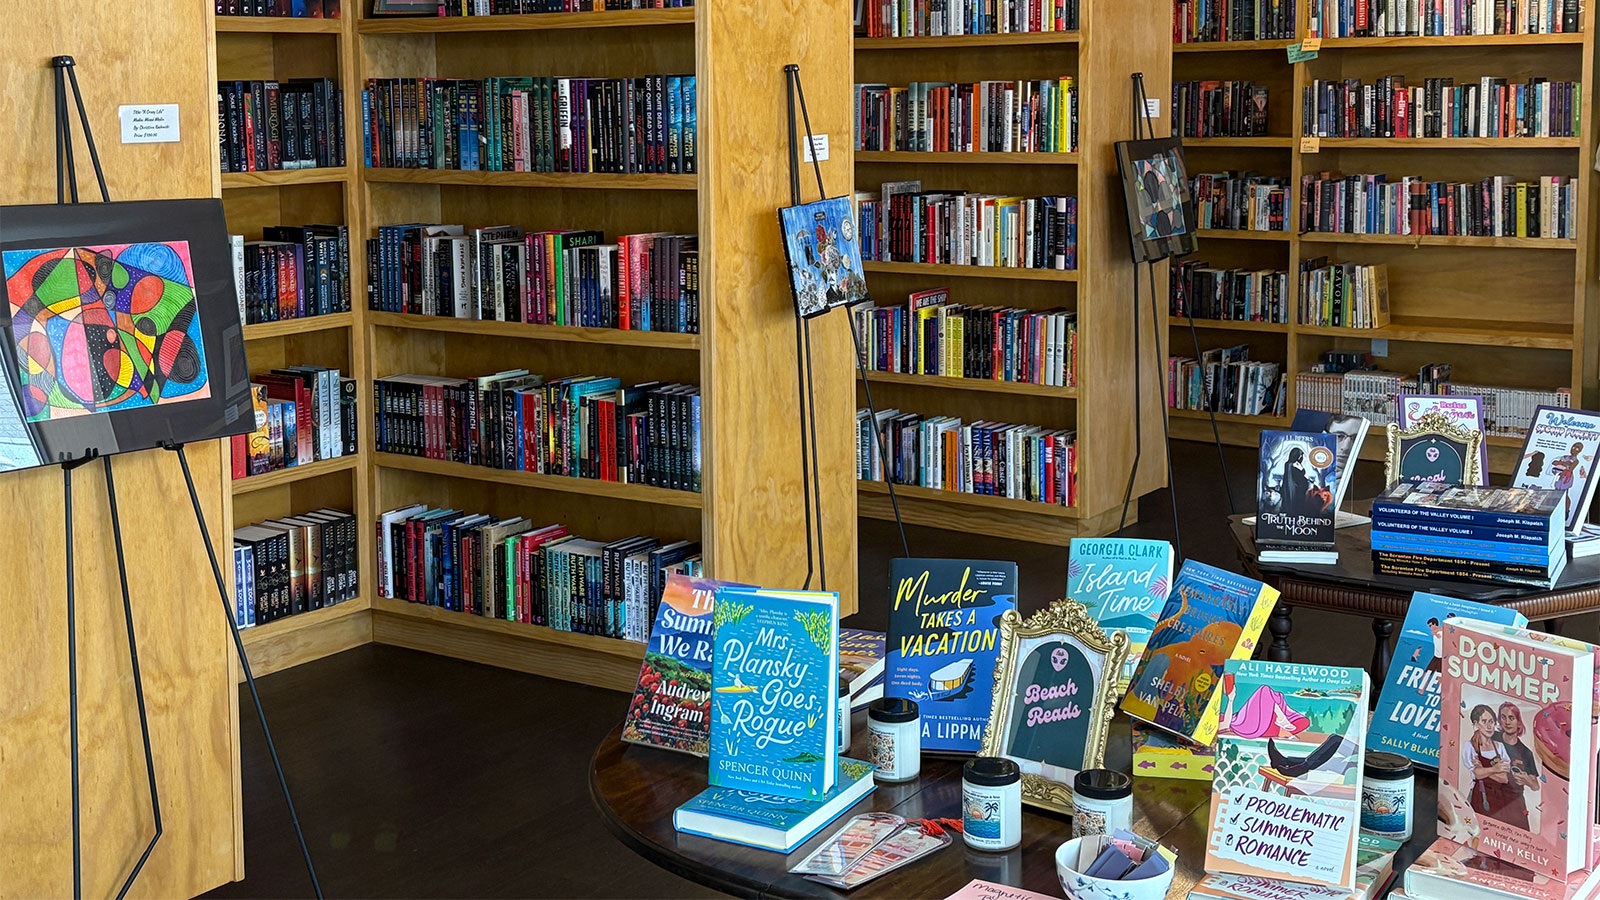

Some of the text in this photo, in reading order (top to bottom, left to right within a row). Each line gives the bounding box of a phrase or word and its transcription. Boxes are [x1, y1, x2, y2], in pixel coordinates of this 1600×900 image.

[269, 97, 279, 142] MURTAGH
[559, 95, 568, 127] GRIFFIN
[306, 231, 314, 263] ENIGMA
[481, 230, 518, 242] STEPHEN
[569, 235, 596, 246] SHARI
[504, 262, 512, 287] KING
[618, 258, 626, 298] CONFIDENTIAL
[1334, 268, 1342, 304] SAVOR
[468, 394, 476, 430] MEZRICH
[1440, 401, 1467, 409] Rules
[505, 410, 514, 458] DEEP DARK
[1536, 424, 1600, 442] SECOND PUBERTY
[1546, 412, 1596, 429] Welcome
[972, 433, 982, 472] MISSION
[983, 433, 992, 472] MISSION
[1045, 447, 1053, 464] WAR
[1261, 513, 1332, 528] TRUTH BEHIND
[1284, 525, 1318, 536] MOON
[1496, 532, 1513, 540] Joseph
[1080, 543, 1163, 558] GEORGIA CLARK
[1424, 556, 1452, 564] Department
[1074, 563, 1158, 594] Island
[1198, 570, 1209, 578] YORK
[1210, 573, 1225, 582] TIMES
[1226, 578, 1258, 592] BESTSELLER
[1426, 568, 1454, 576] Department
[692, 588, 714, 612] Th
[894, 566, 988, 616] Murder
[1098, 588, 1154, 619] Time
[1178, 584, 1246, 615] REMARKABLY
[661, 608, 713, 636] Sum
[920, 609, 976, 629] TAKES A
[1184, 605, 1224, 626] BRIGHT
[756, 628, 789, 650] Mrs.
[901, 628, 998, 658] VACATION
[1168, 618, 1226, 646] CREATURES
[660, 634, 712, 662] We Ra
[1179, 654, 1192, 664] NOVEL
[1458, 635, 1555, 680] DONUT
[723, 638, 809, 688] Plansky
[1239, 662, 1349, 678] ALI HAZELWOOD
[1024, 678, 1078, 704] Beach
[1150, 676, 1189, 698] SHELBY
[1275, 674, 1300, 682] Bestselling
[1396, 665, 1442, 696] FRIE
[1447, 655, 1560, 704] SUMMER
[656, 680, 710, 706] Audrey
[760, 679, 817, 715] Goes
[1138, 691, 1186, 718] VAN PELT
[1424, 694, 1440, 706] TO
[650, 700, 704, 733] Ingram
[733, 699, 806, 749] Rogue
[1026, 702, 1082, 728] Reads
[1390, 700, 1441, 732] LOVE
[938, 722, 981, 740] LIPPM
[1381, 736, 1441, 758] SALLY BLAKE
[719, 760, 812, 783] SPENCER QUINN
[1245, 796, 1344, 832] PROBLEMATIC
[1240, 816, 1314, 847] SUMMER
[1235, 836, 1312, 866] ROMANCE
[1483, 836, 1549, 866] ANITA KELLY
